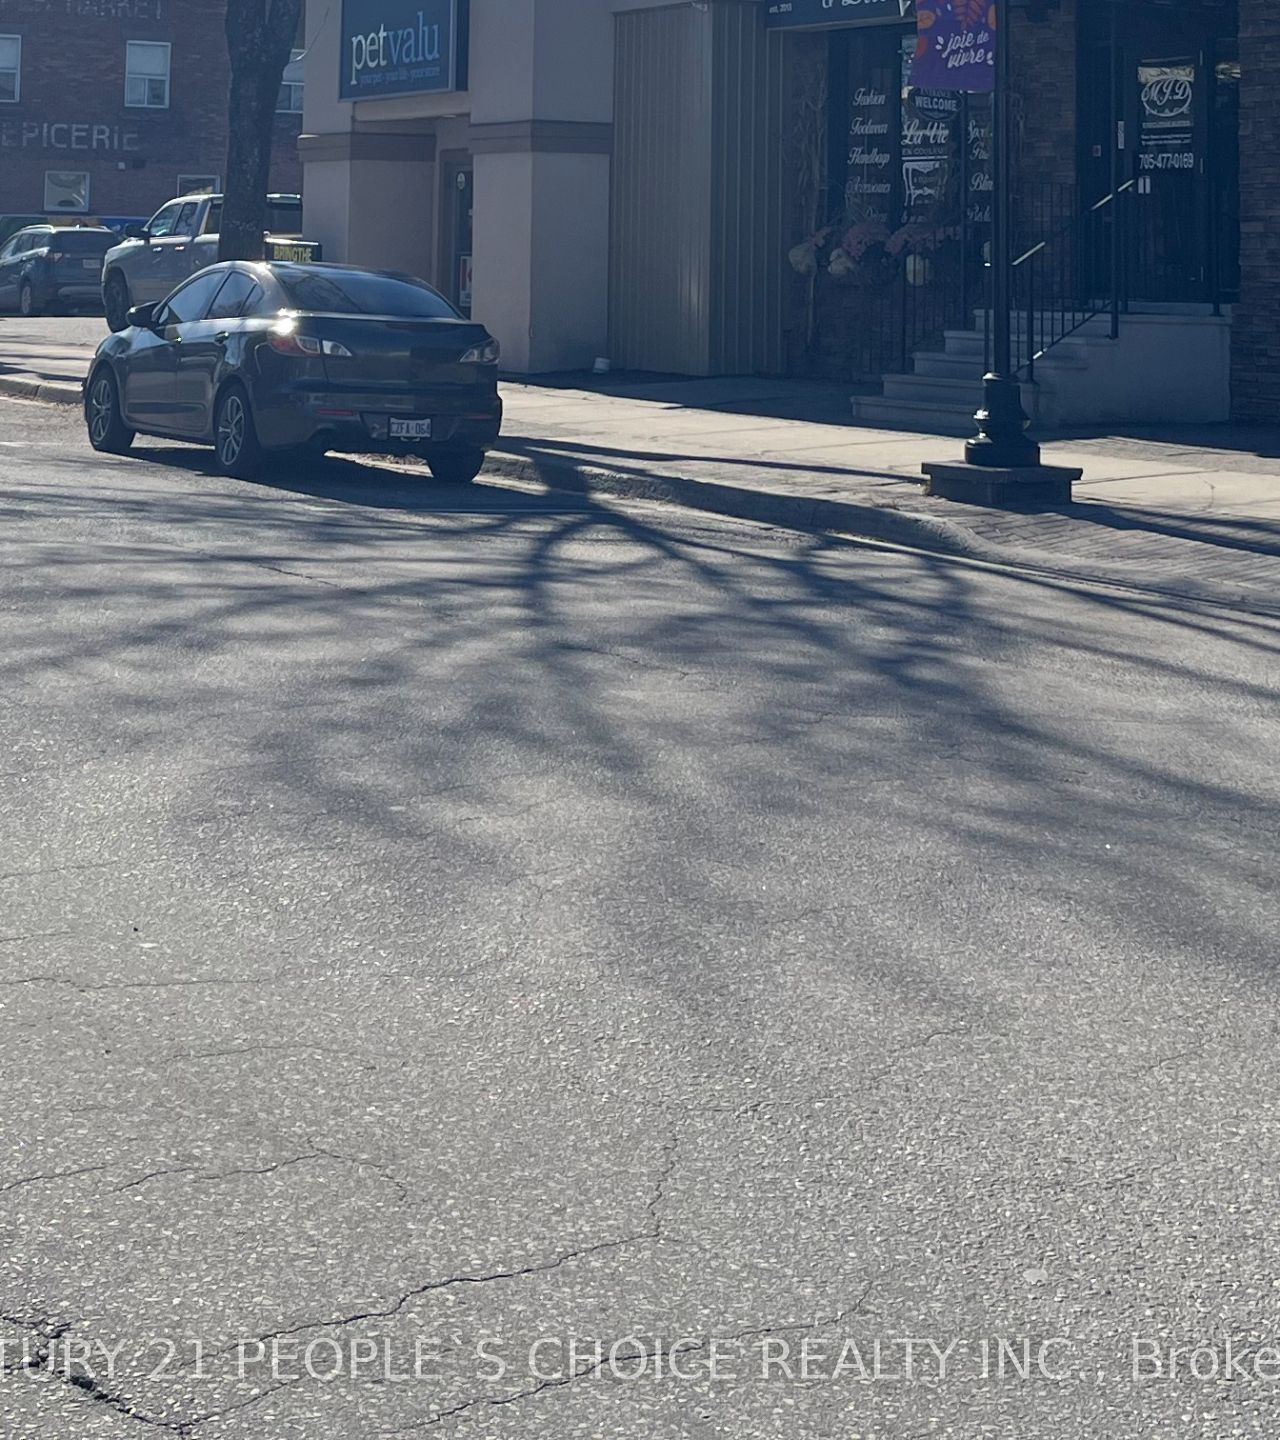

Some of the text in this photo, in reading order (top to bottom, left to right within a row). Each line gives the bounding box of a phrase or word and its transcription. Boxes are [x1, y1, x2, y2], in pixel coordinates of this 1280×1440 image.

[942, 30, 989, 58] joie de
[948, 49, 985, 68] vivre
[915, 96, 959, 112] WELCOME
[1, 122, 142, 152] EPICERIE
